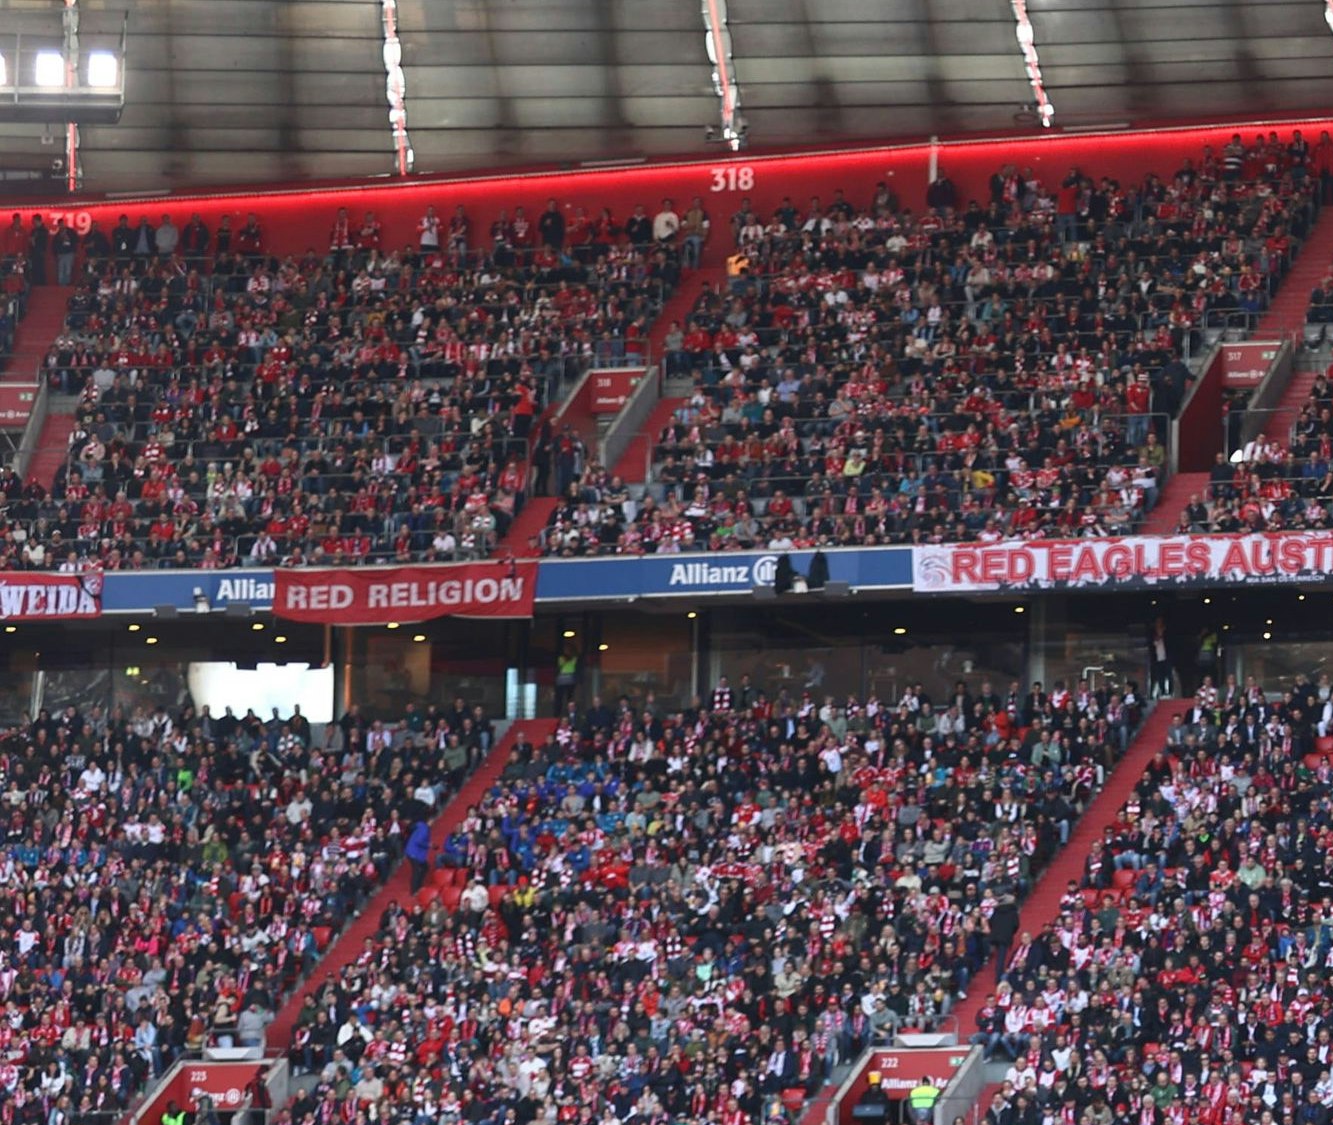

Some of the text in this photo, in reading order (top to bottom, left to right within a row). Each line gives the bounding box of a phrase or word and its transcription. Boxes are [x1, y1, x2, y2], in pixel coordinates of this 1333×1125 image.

[709, 168, 754, 192] 318
[669, 562, 749, 585] Allianz
[951, 549, 1035, 584] RED
[1048, 542, 1212, 582] EAGLES
[286, 577, 523, 609] RED RELIGION
[881, 1057, 899, 1068] 222
[881, 1078, 918, 1089] Allianz
